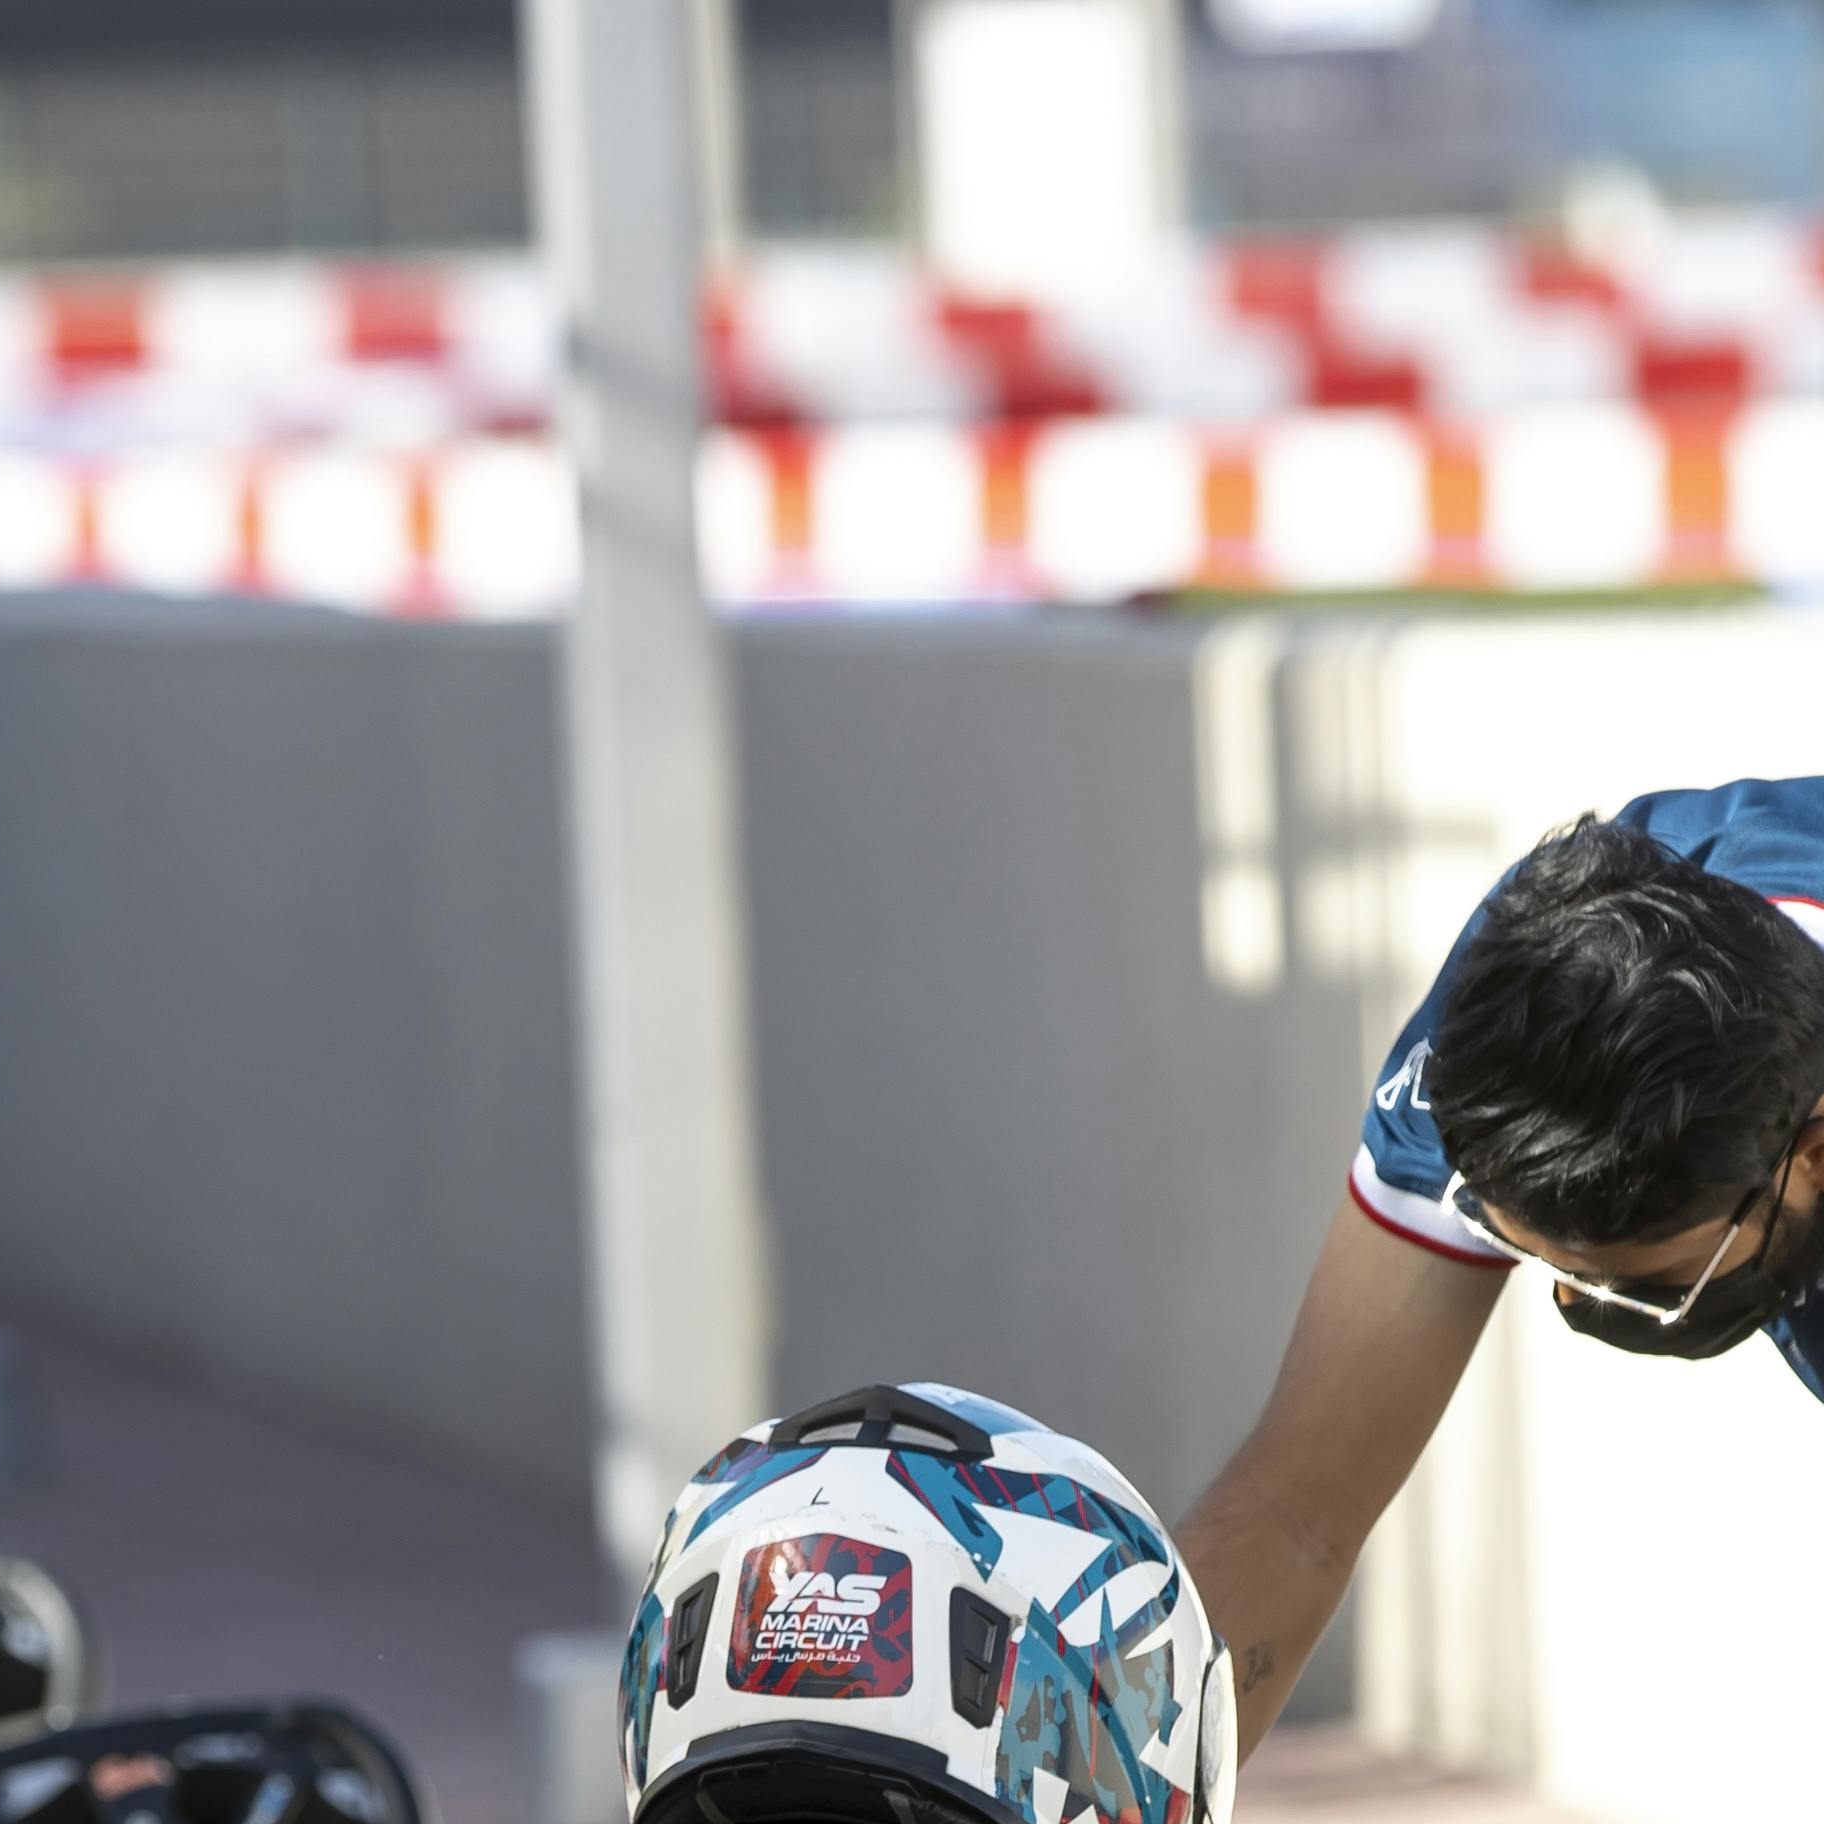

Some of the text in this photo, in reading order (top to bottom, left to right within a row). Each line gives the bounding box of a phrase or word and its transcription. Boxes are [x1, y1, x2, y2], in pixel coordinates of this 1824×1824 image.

[768, 1572, 887, 1615] YAS
[761, 1614, 869, 1633] MARINA
[756, 1632, 867, 1650] CIRCUIT
